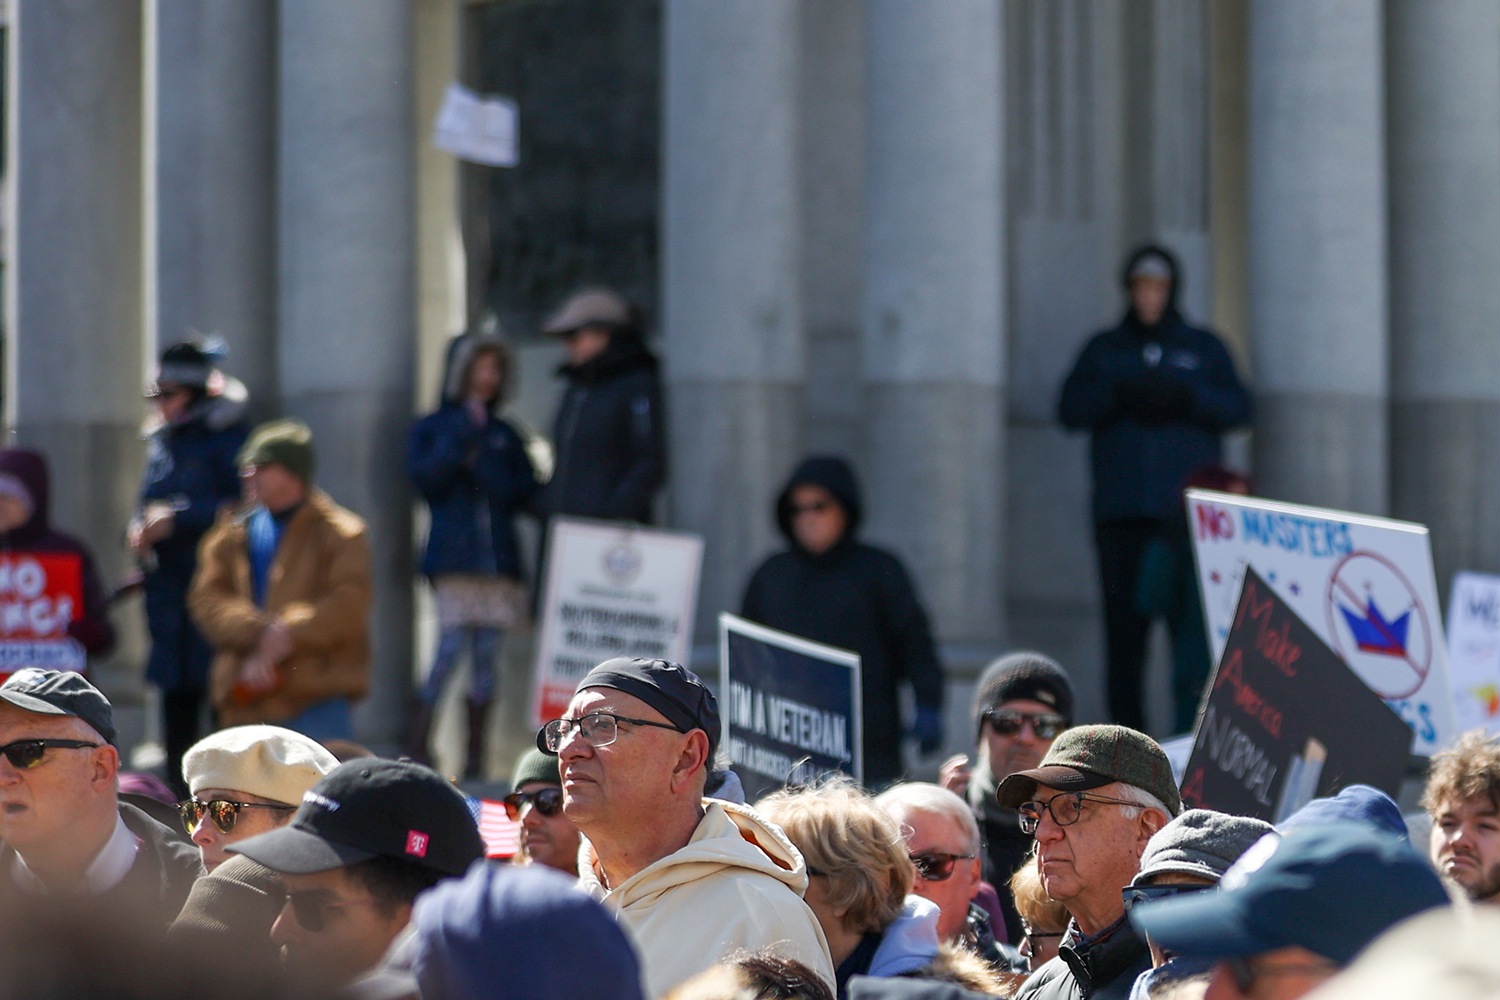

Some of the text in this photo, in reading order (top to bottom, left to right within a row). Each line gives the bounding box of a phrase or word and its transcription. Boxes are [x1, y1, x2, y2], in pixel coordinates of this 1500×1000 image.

[1195, 504, 1353, 558] NO MASTERS
[1235, 582, 1301, 678] Make
[752, 689, 767, 736] A
[1199, 704, 1274, 807] NORMAL
